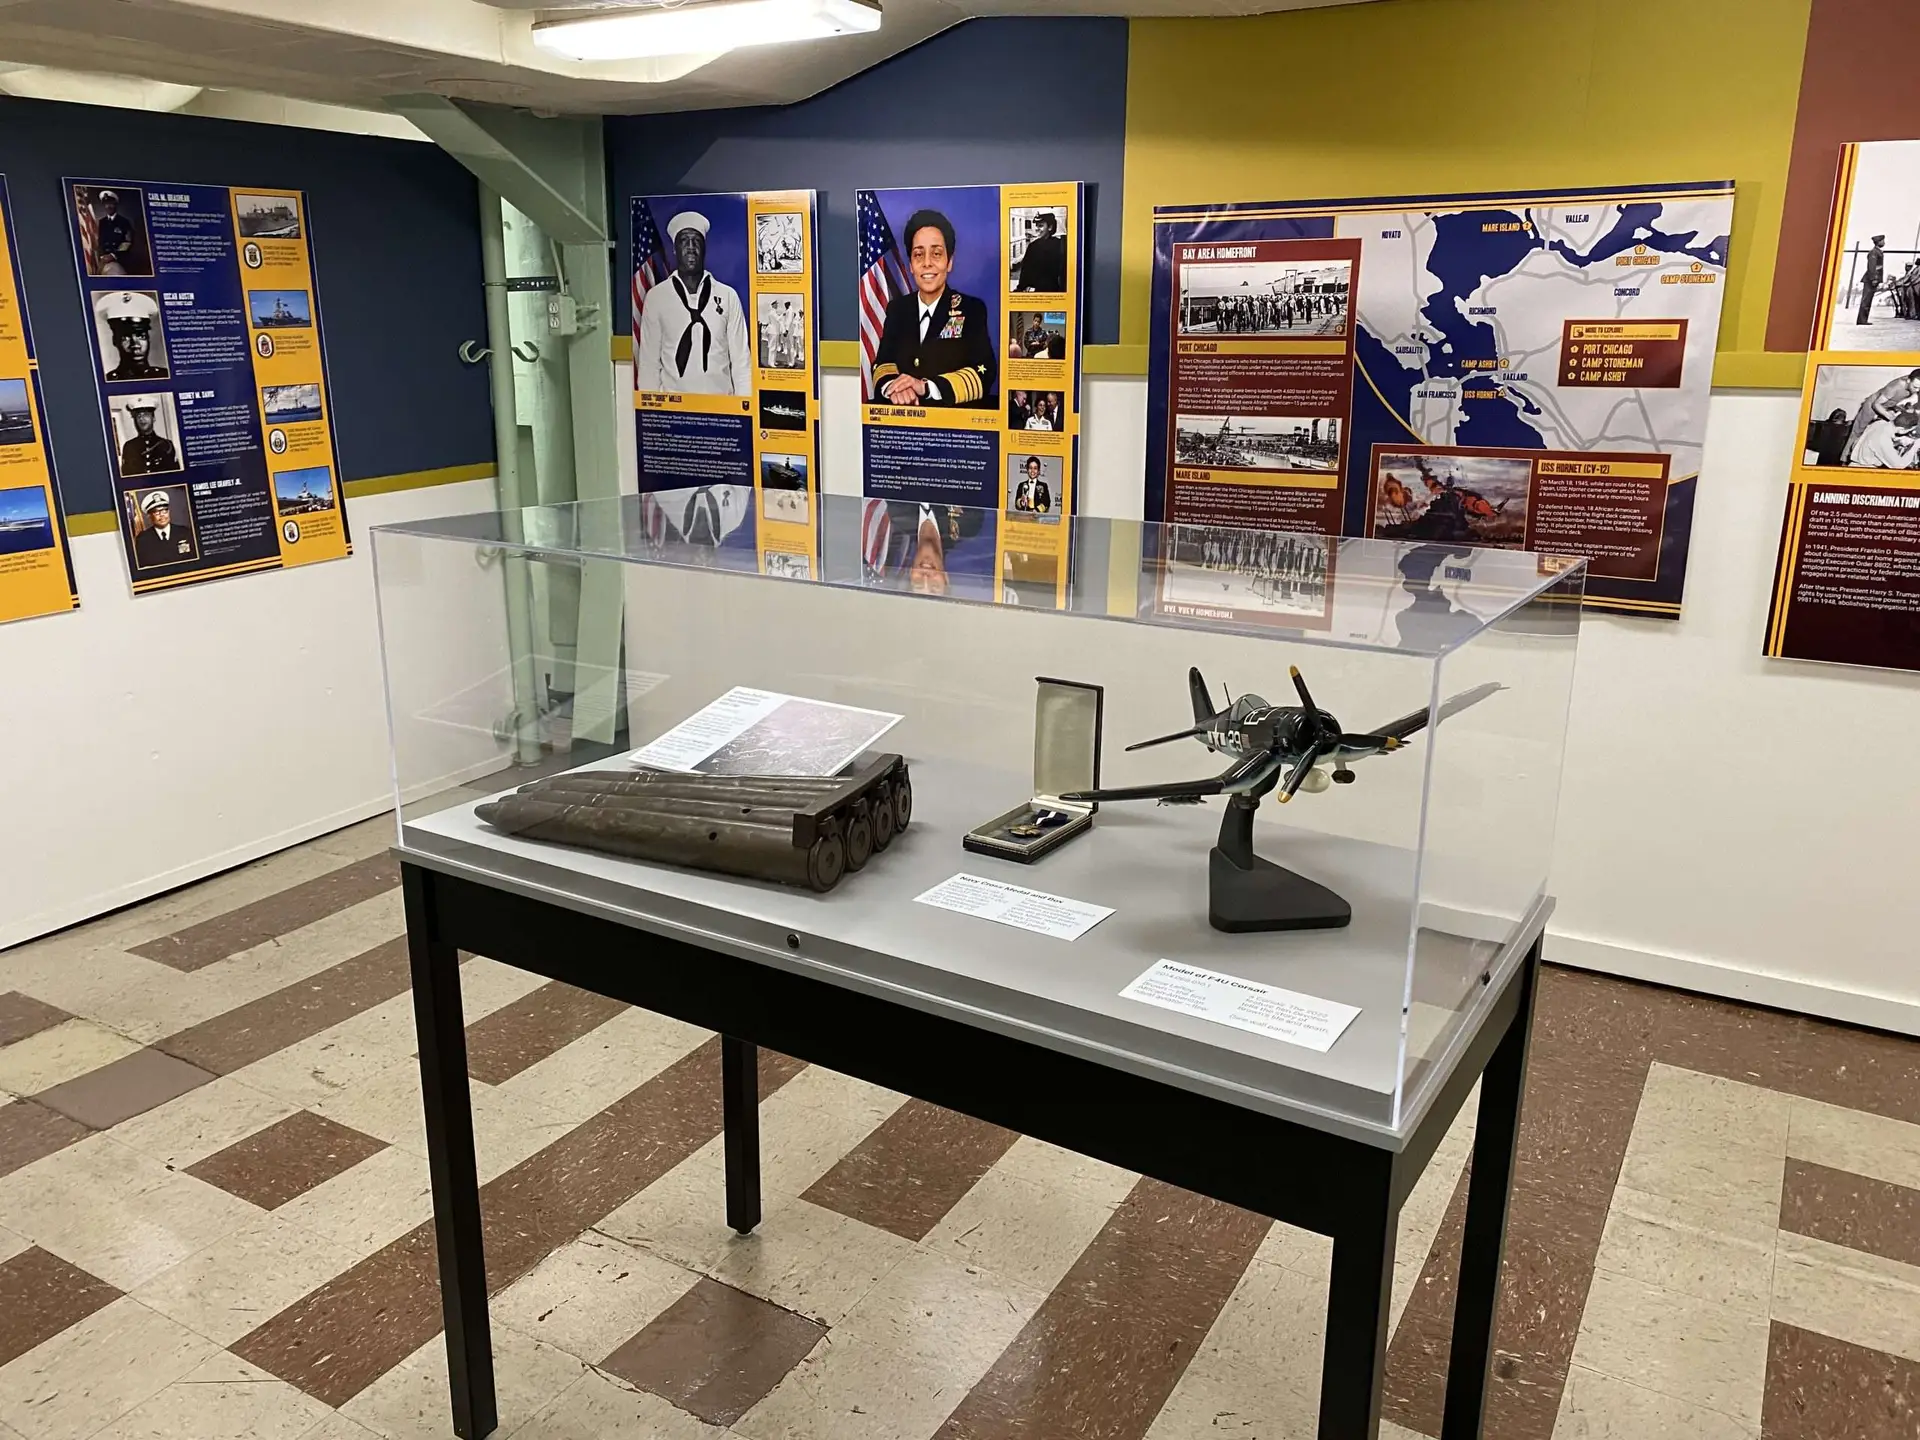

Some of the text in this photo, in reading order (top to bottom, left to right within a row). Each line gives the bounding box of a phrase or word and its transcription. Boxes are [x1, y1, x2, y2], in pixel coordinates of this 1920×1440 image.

[1566, 215, 1589, 223] VALLEJO
[1482, 223, 1520, 232] MARE ISLAND
[1183, 247, 1257, 259] BAY AREA HOMEFRONT
[1616, 256, 1660, 266] PORT CHICAGO
[1661, 274, 1715, 284] CAMP STONEMAN
[1614, 288, 1640, 296] CONCORD
[1179, 343, 1217, 352] PORT CHICAGO
[1395, 346, 1423, 354] SAUSALITO
[1583, 344, 1633, 354] PORT CHICAGO
[1461, 360, 1497, 368] CAMP ASHBY
[1582, 358, 1643, 368] CAMP STONEMAN
[1580, 371, 1626, 381] CAMP ASHBY
[870, 408, 889, 416] MICHELLE
[1541, 463, 1609, 474] USS HORNET (CV-12)
[1176, 470, 1210, 481] MARE ISLAND
[1813, 492, 1920, 508] BANNING DISCRIMINATION
[1823, 552, 1866, 560] discrimination
[1802, 564, 1839, 572] employment
[1840, 566, 1868, 574] practices
[1839, 586, 1868, 594] President
[981, 881, 1003, 889] Cross
[1004, 887, 1030, 895] Medal
[1162, 964, 1194, 975] Model
[1208, 976, 1229, 984] F4U
[1231, 982, 1269, 994] Corsair
